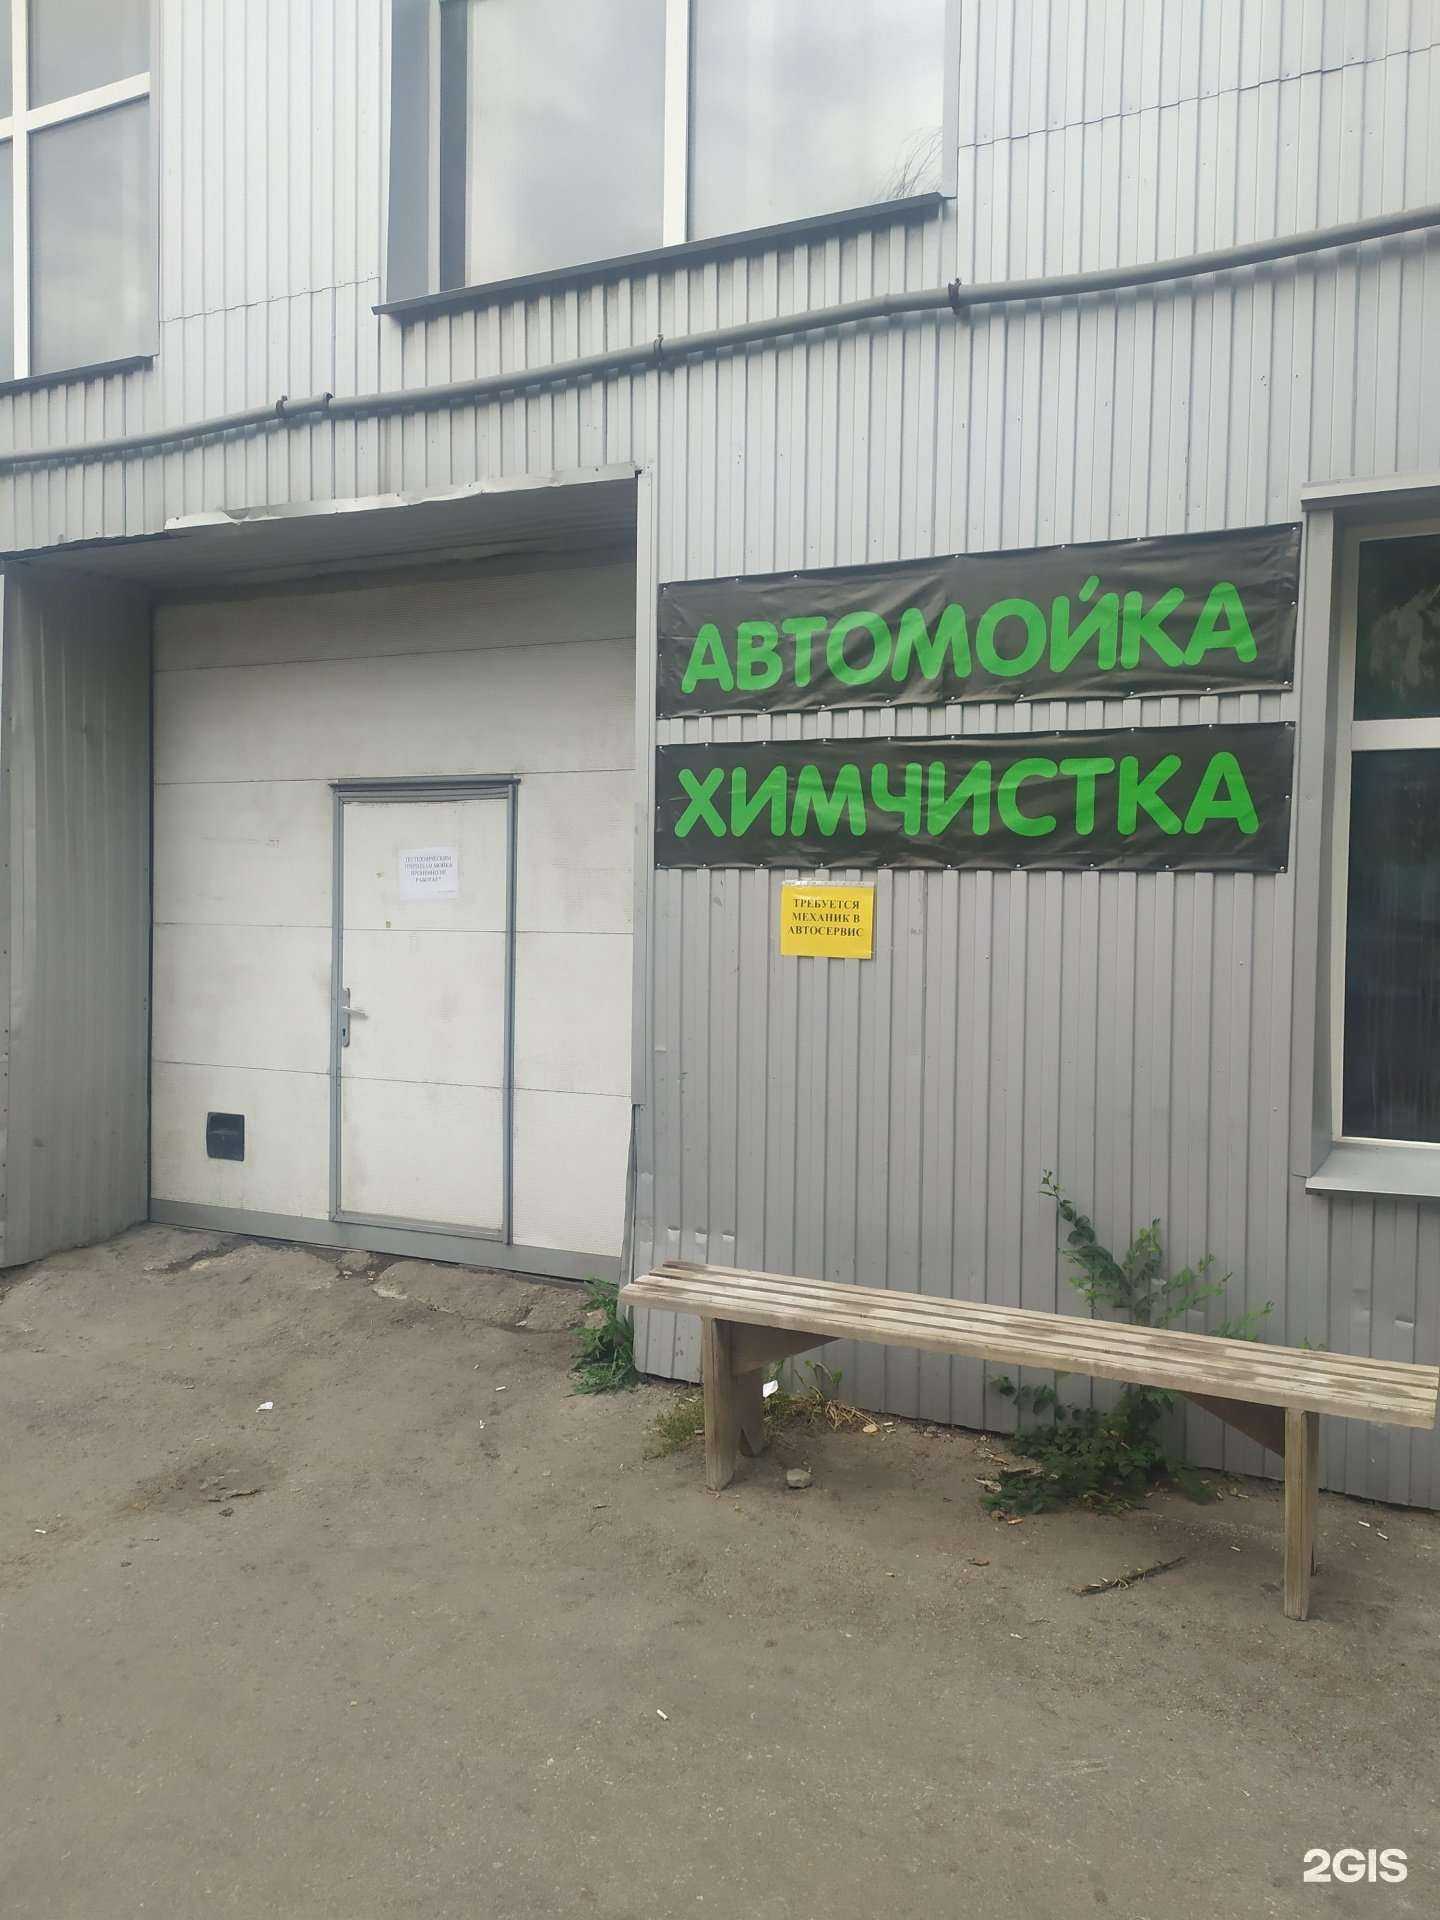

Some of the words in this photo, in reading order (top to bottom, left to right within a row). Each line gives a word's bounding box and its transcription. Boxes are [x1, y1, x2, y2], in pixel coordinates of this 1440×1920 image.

[682, 577, 1257, 693] АВТОМОЙКА
[676, 752, 1258, 837] ХИМЧИСТКА
[793, 898, 860, 909] ТРЕБУЕТСЯ
[792, 912, 850, 923] МЕХАНИК
[853, 914, 860, 923] В
[788, 925, 864, 937] АВТОСЕРВИС
